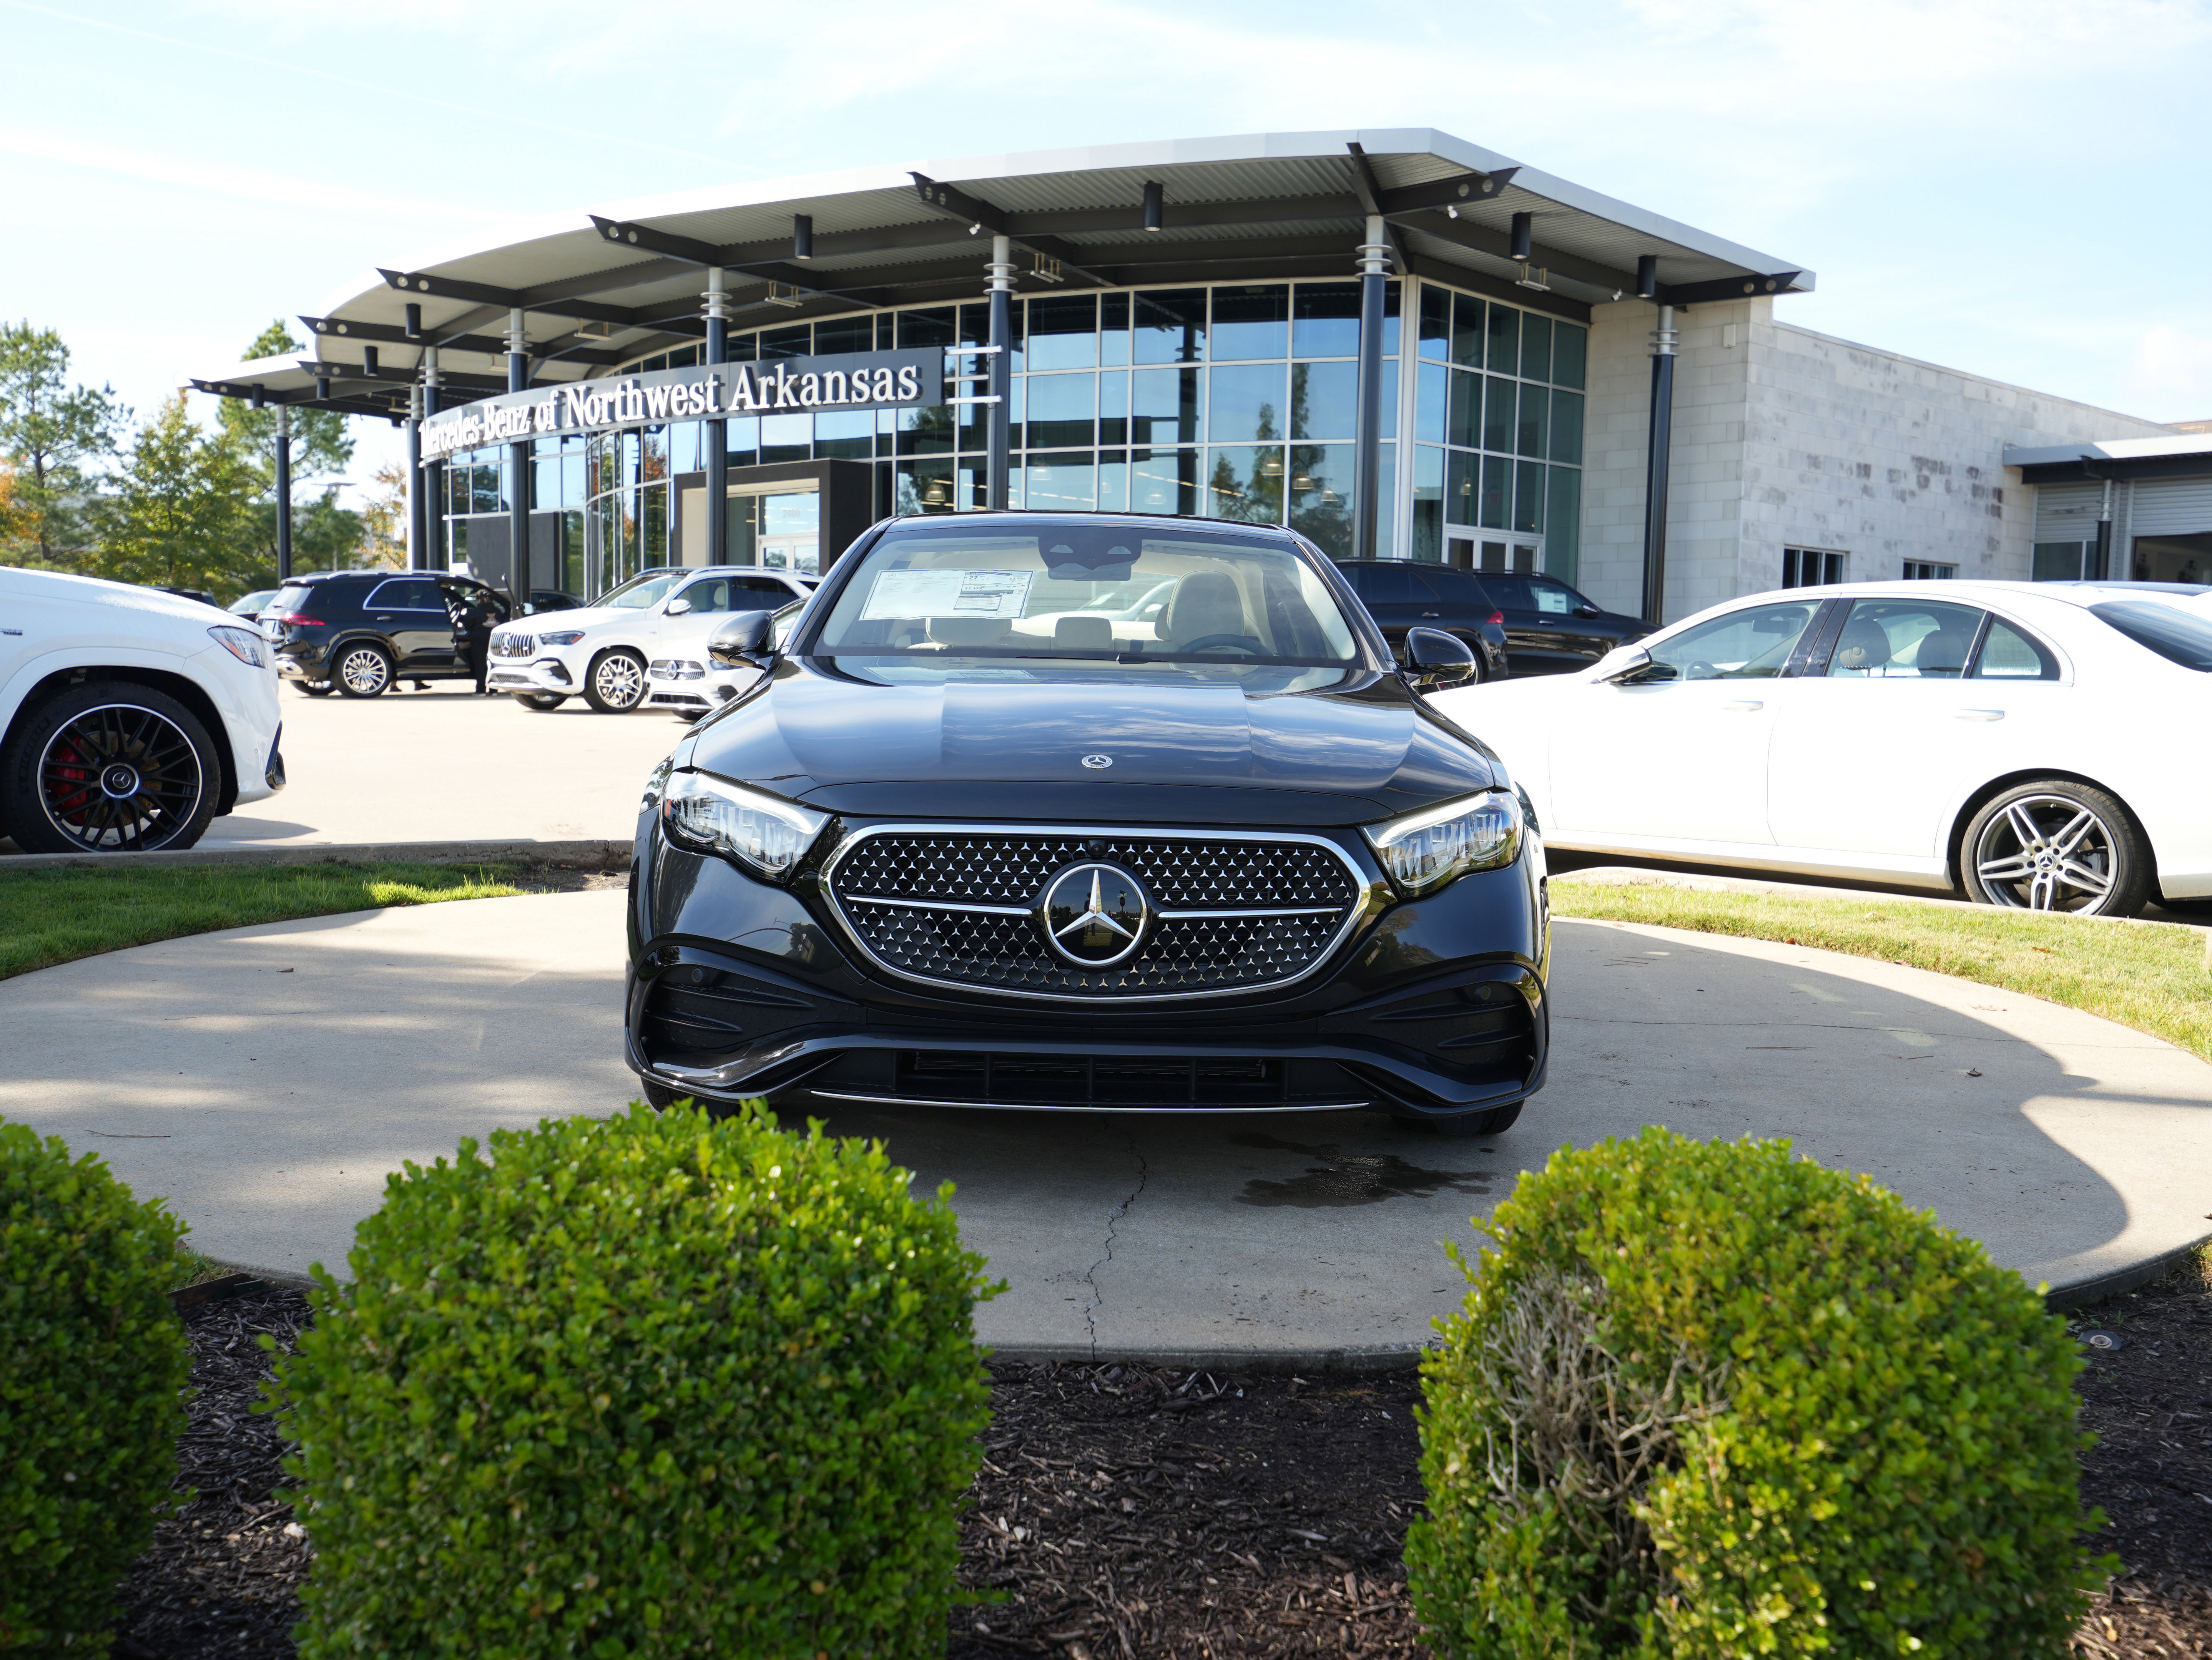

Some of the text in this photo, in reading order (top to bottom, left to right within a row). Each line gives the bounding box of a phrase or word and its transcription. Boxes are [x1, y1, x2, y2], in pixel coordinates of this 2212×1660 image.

[418, 363, 918, 458] Mercedes-Benz of Northwest Arkansas
[783, 508, 801, 519] 2400
